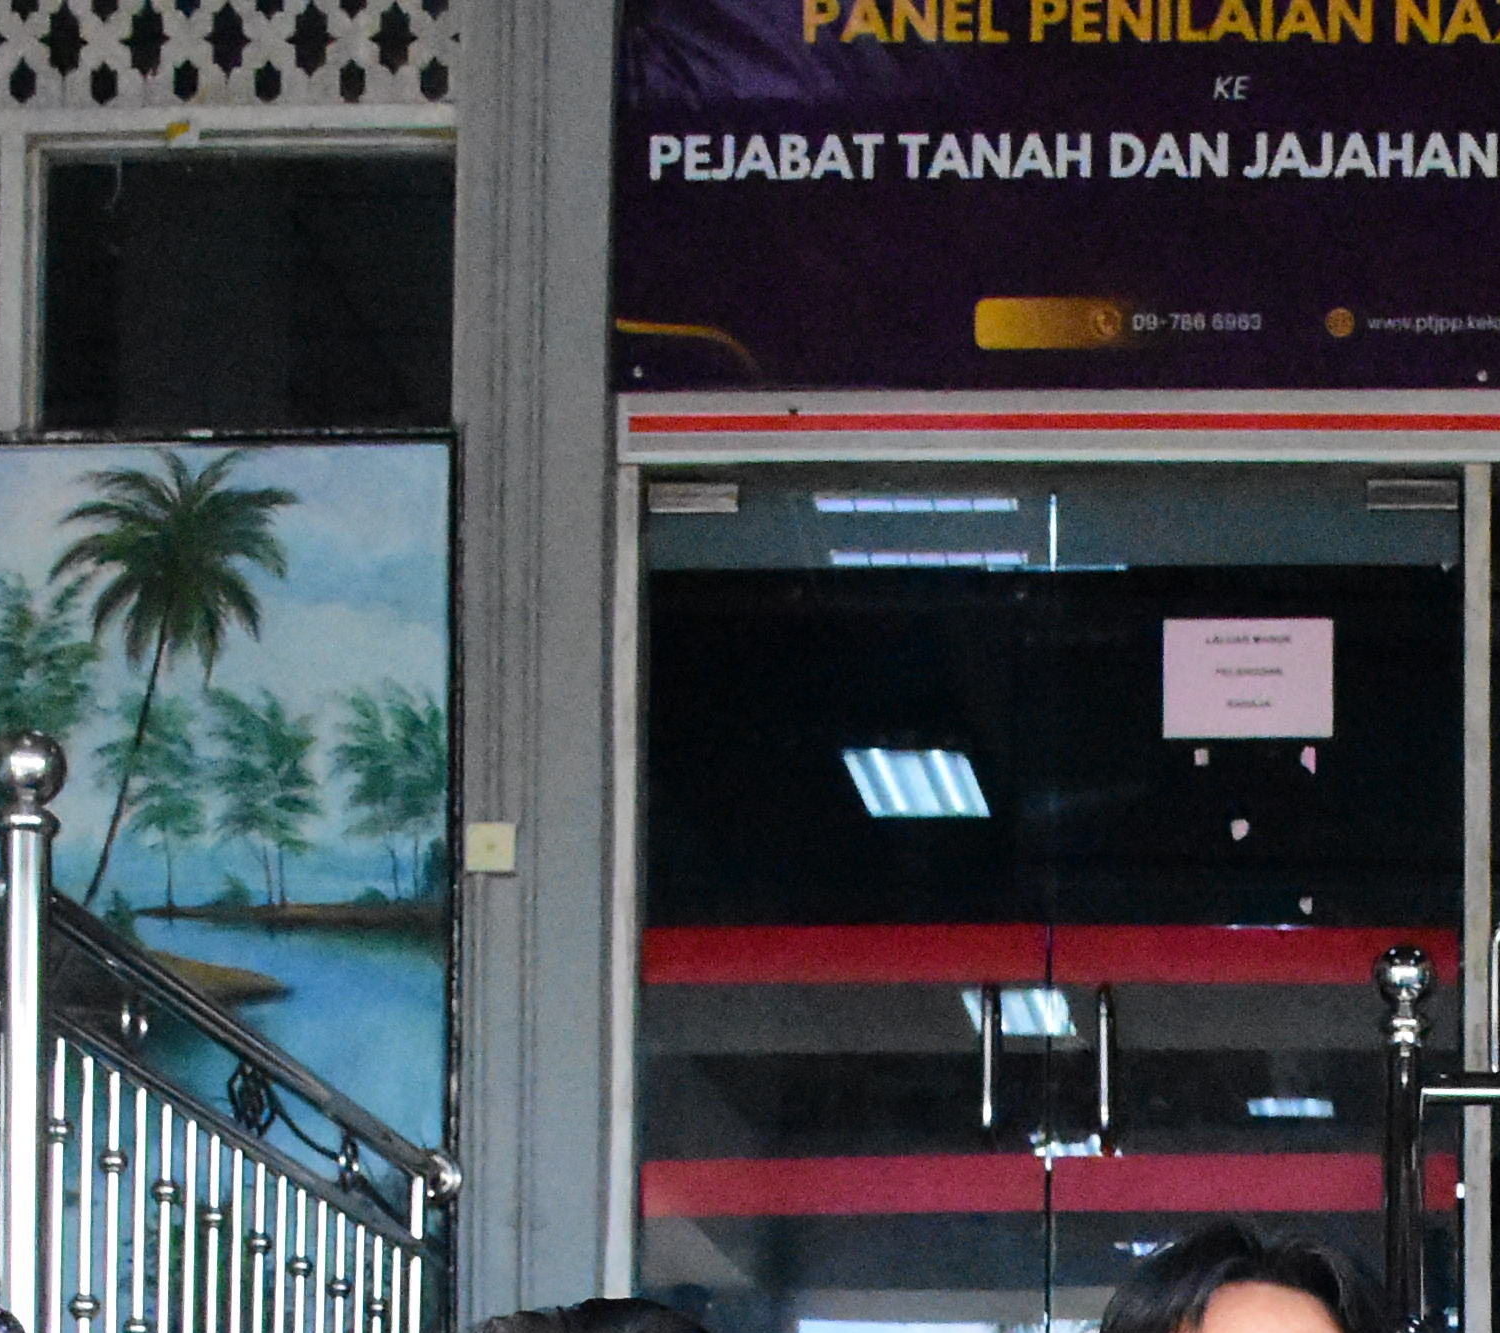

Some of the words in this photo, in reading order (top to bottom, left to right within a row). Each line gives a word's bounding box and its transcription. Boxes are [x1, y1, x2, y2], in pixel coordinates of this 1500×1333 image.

[802, 0, 1010, 43] PANEL
[1029, 0, 1374, 43] PENILAIAN
[1212, 75, 1251, 100] KE
[648, 132, 885, 181] PEJABAT
[898, 131, 1092, 180] TANAH
[1108, 131, 1230, 180] DAN
[1242, 131, 1499, 180] JAJAHAN
